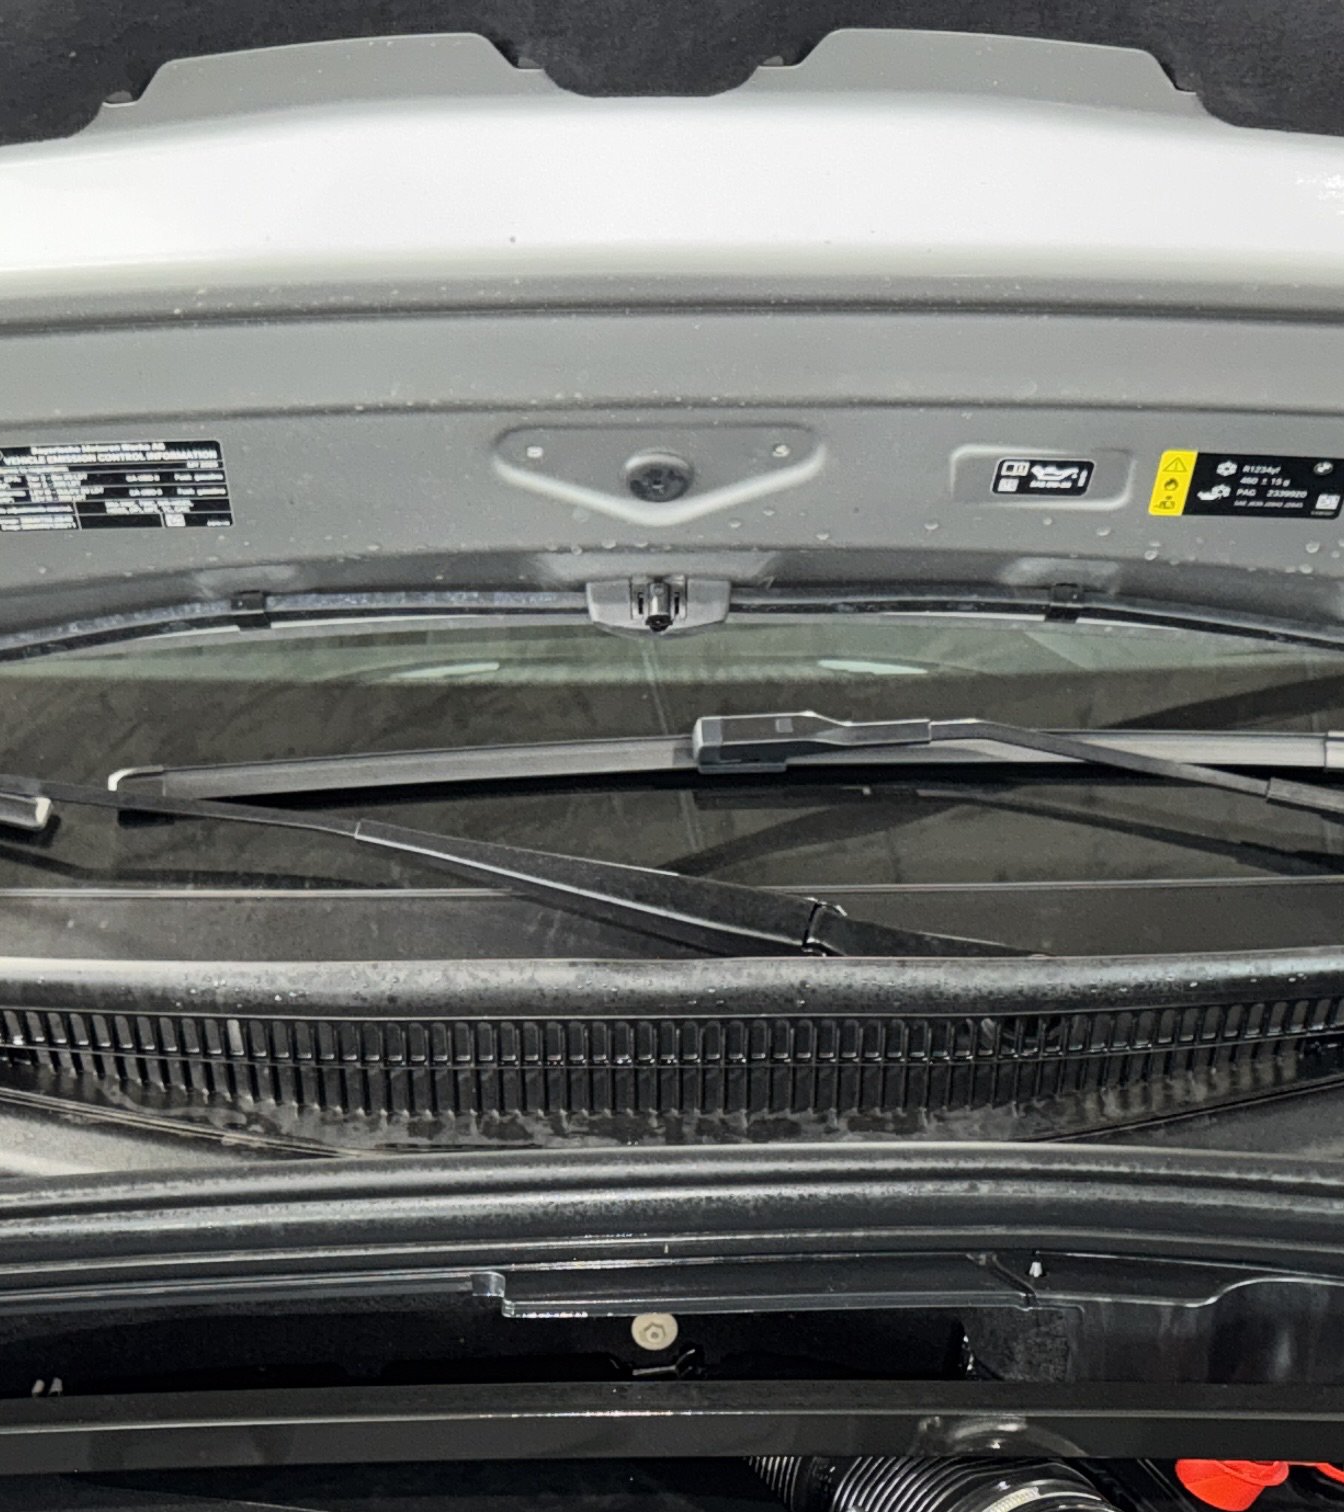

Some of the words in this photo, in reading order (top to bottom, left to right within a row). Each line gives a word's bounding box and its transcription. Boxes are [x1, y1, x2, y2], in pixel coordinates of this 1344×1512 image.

[3, 455, 46, 466] VEHICLE
[47, 453, 97, 465] EMISSION
[97, 451, 146, 462] CONTROL
[146, 449, 218, 461] INFORMATION
[1236, 488, 1257, 497] PAG
